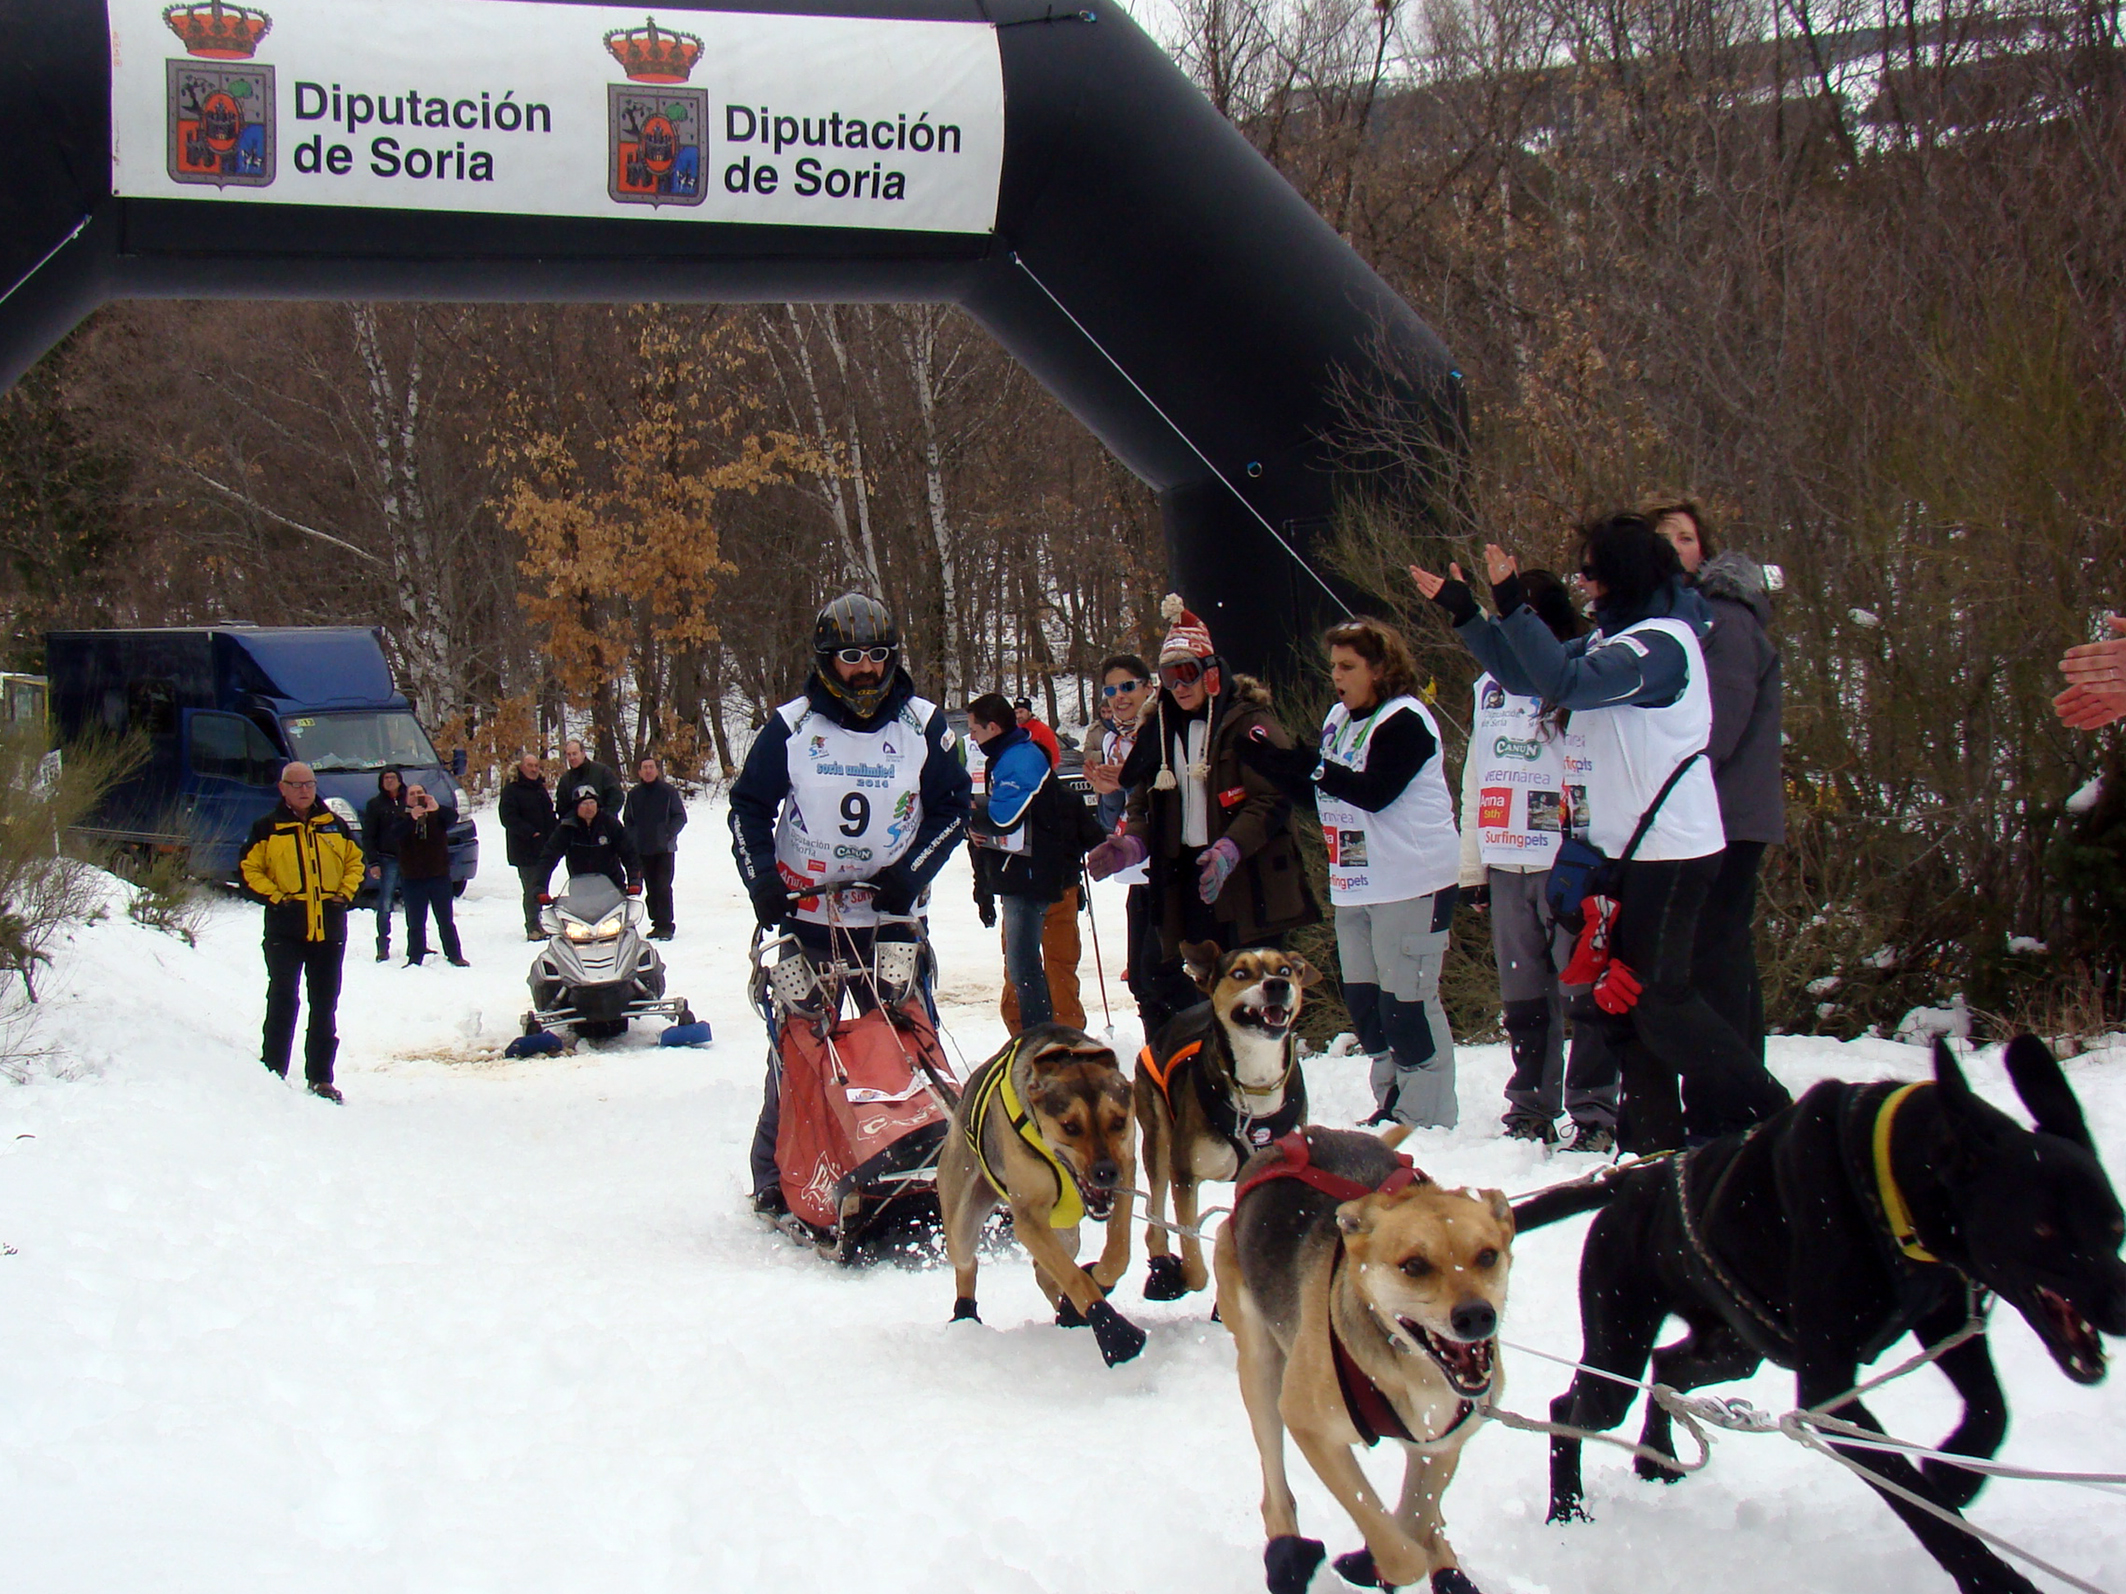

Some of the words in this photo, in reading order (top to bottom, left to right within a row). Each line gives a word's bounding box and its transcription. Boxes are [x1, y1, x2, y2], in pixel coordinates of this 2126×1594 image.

[294, 81, 552, 133] Diputación
[726, 104, 961, 154] Diputación
[293, 134, 354, 175] de
[370, 136, 495, 182] Soria
[724, 155, 779, 195] de
[794, 157, 906, 200] Soria
[816, 761, 844, 776] soria
[845, 763, 895, 778] unlimited
[1496, 741, 1538, 757] CANUN
[856, 779, 889, 788] 2014
[839, 792, 871, 838] 9
